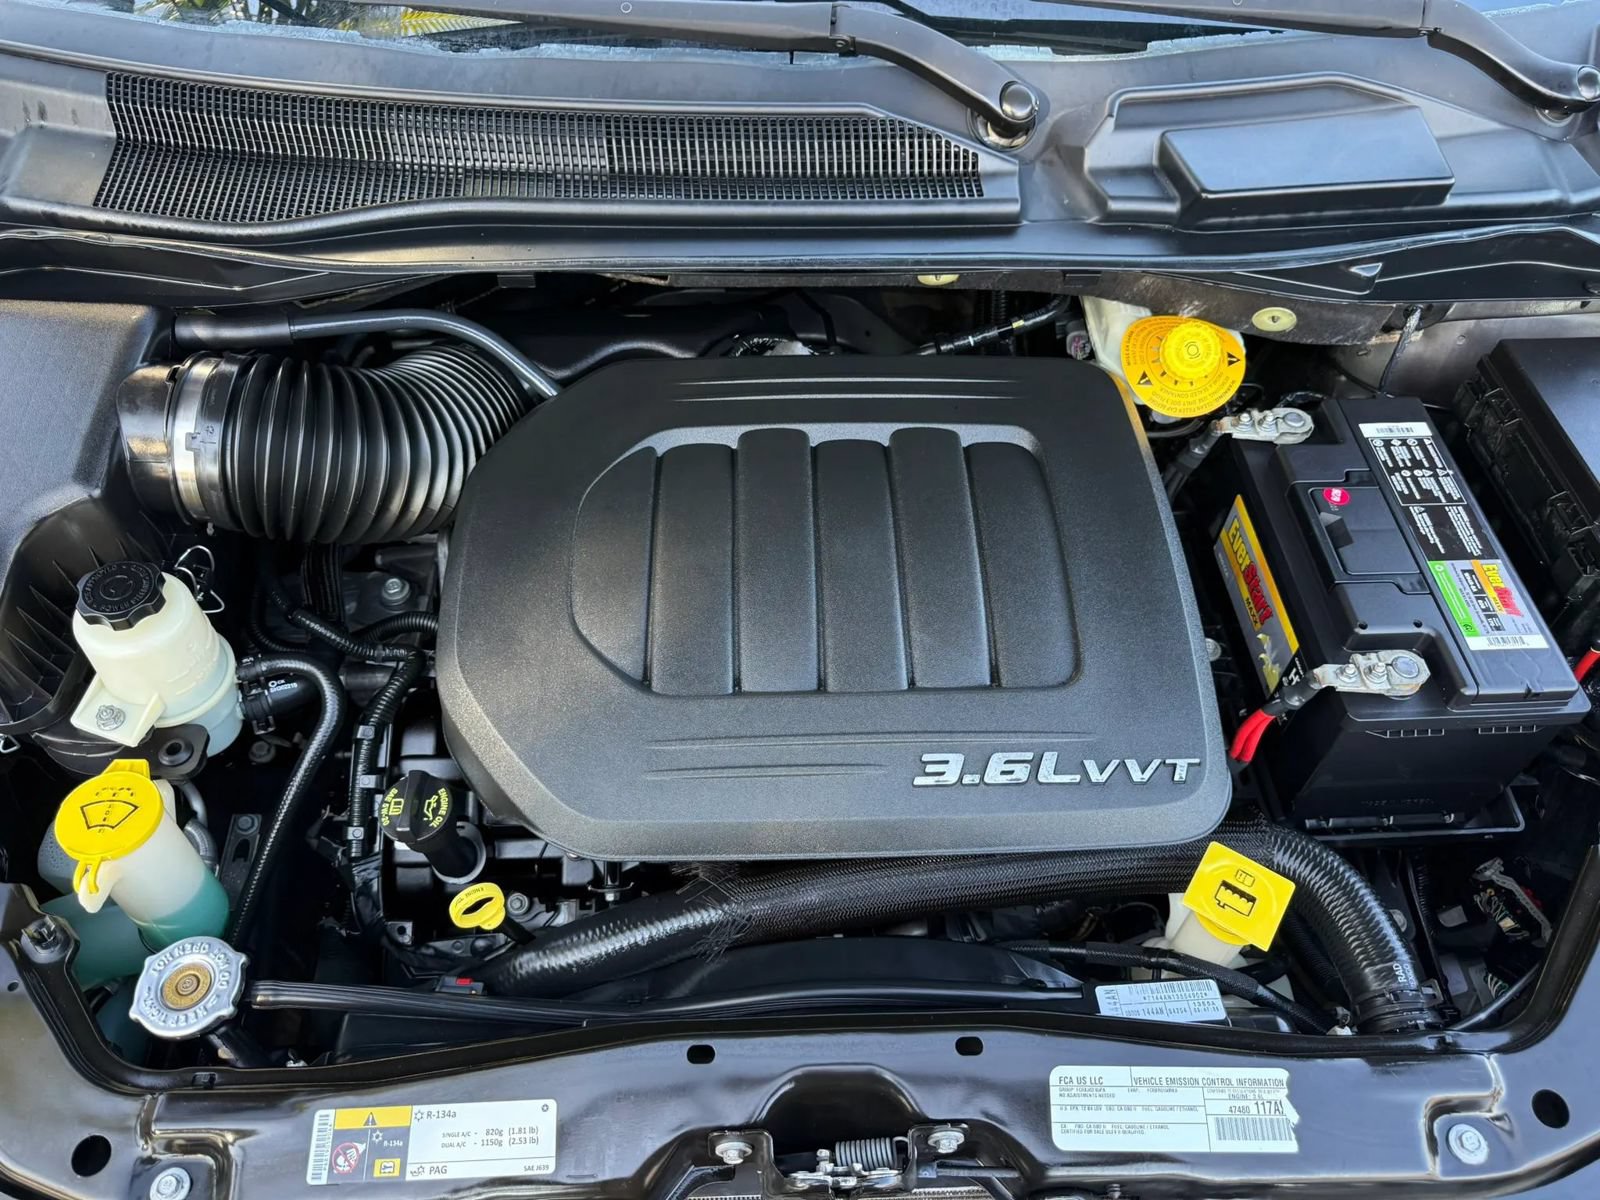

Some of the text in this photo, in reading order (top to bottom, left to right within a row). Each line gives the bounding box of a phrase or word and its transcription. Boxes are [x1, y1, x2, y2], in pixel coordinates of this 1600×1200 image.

[1228, 517, 1273, 625] EverStart
[912, 751, 1200, 787] 3.6L VVT
[381, 788, 398, 826] SAE 5W-20
[429, 788, 448, 828] ENGINE OIL
[174, 942, 210, 958] OPEN
[152, 955, 173, 976] HOT
[1393, 963, 1407, 983] RAD
[1058, 1076, 1104, 1085] FCA US LLC
[1133, 1077, 1285, 1087] VEHICLE EMISSION CONTROL INFORMATION
[426, 1110, 457, 1120] R-134a
[485, 1128, 504, 1137] 820g
[508, 1127, 527, 1137] (1.81
[528, 1126, 539, 1135] lb)
[456, 1141, 467, 1149] A/C
[481, 1138, 503, 1147] 1150g
[508, 1137, 527, 1147] (2.53
[529, 1136, 539, 1146] lb)
[429, 1165, 448, 1175] PAG
[535, 1164, 550, 1172] J639
